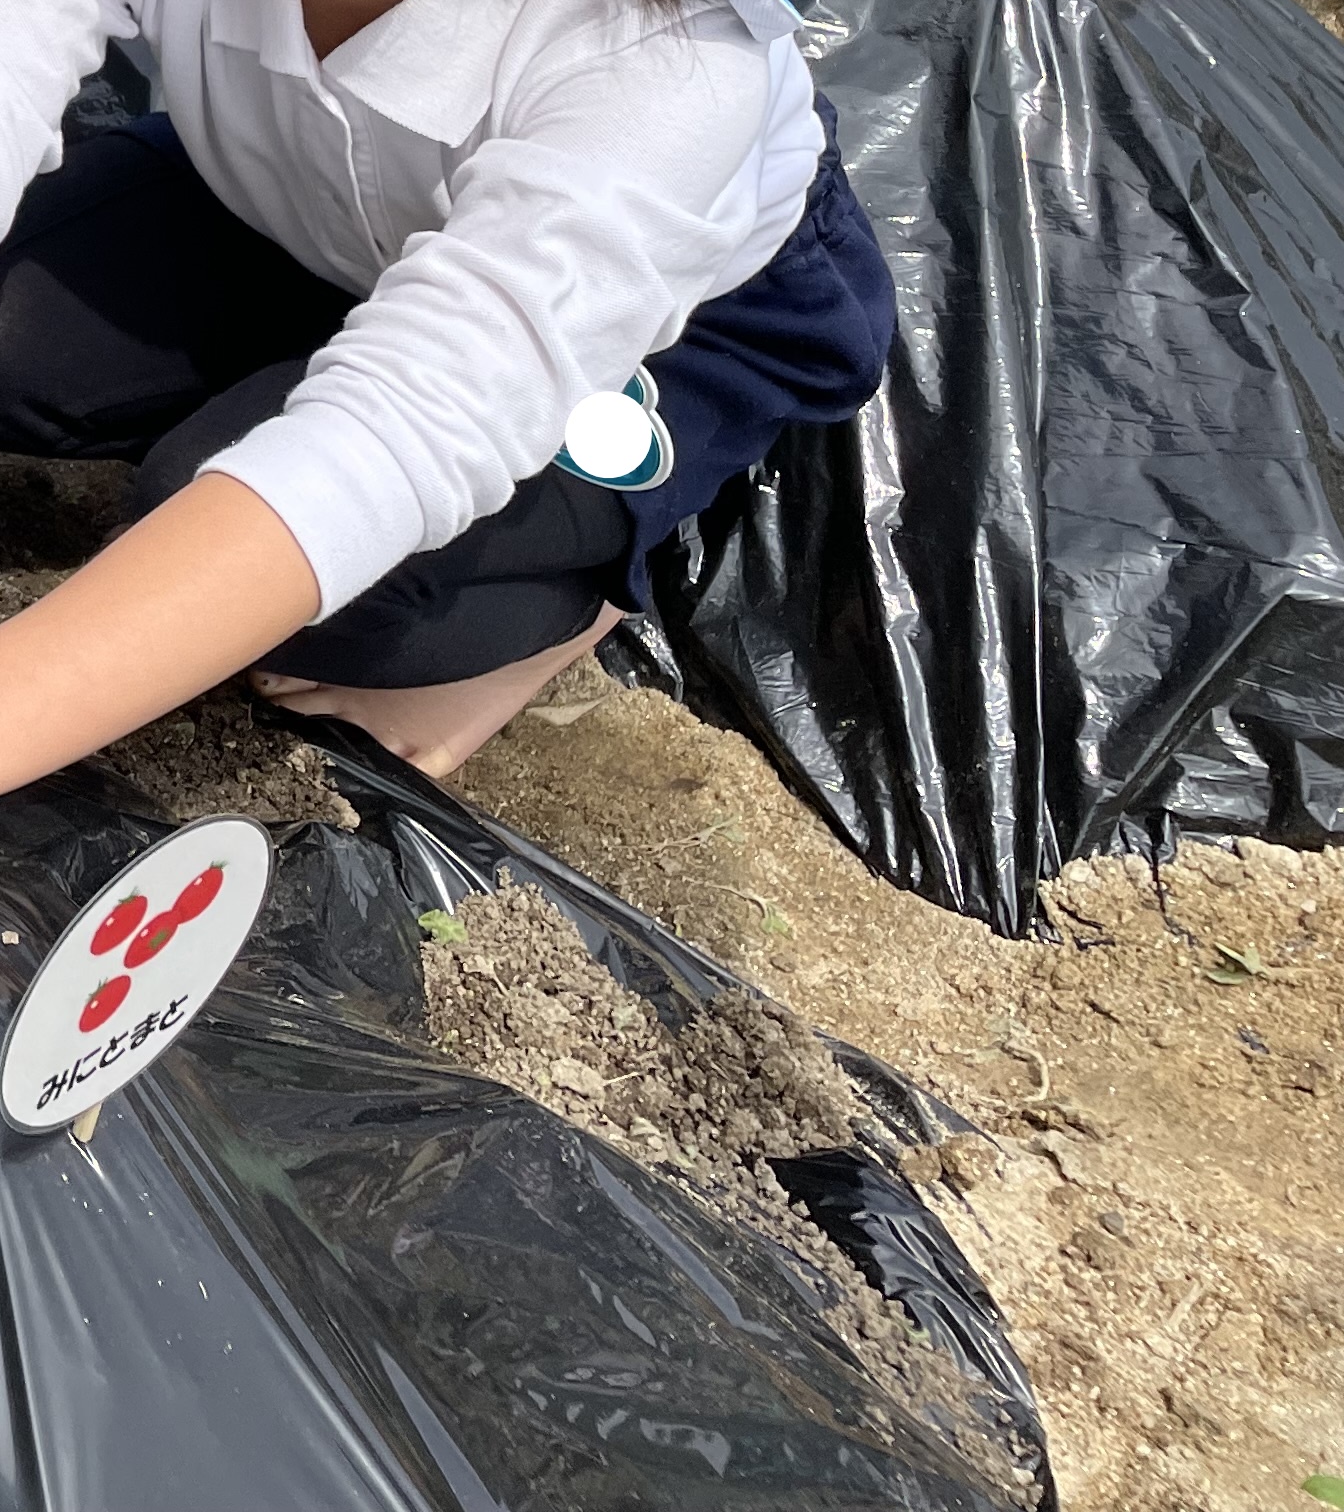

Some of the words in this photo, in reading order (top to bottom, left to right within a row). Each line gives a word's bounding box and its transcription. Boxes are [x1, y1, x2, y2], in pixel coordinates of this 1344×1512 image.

[36, 994, 189, 1110] みにとまと
